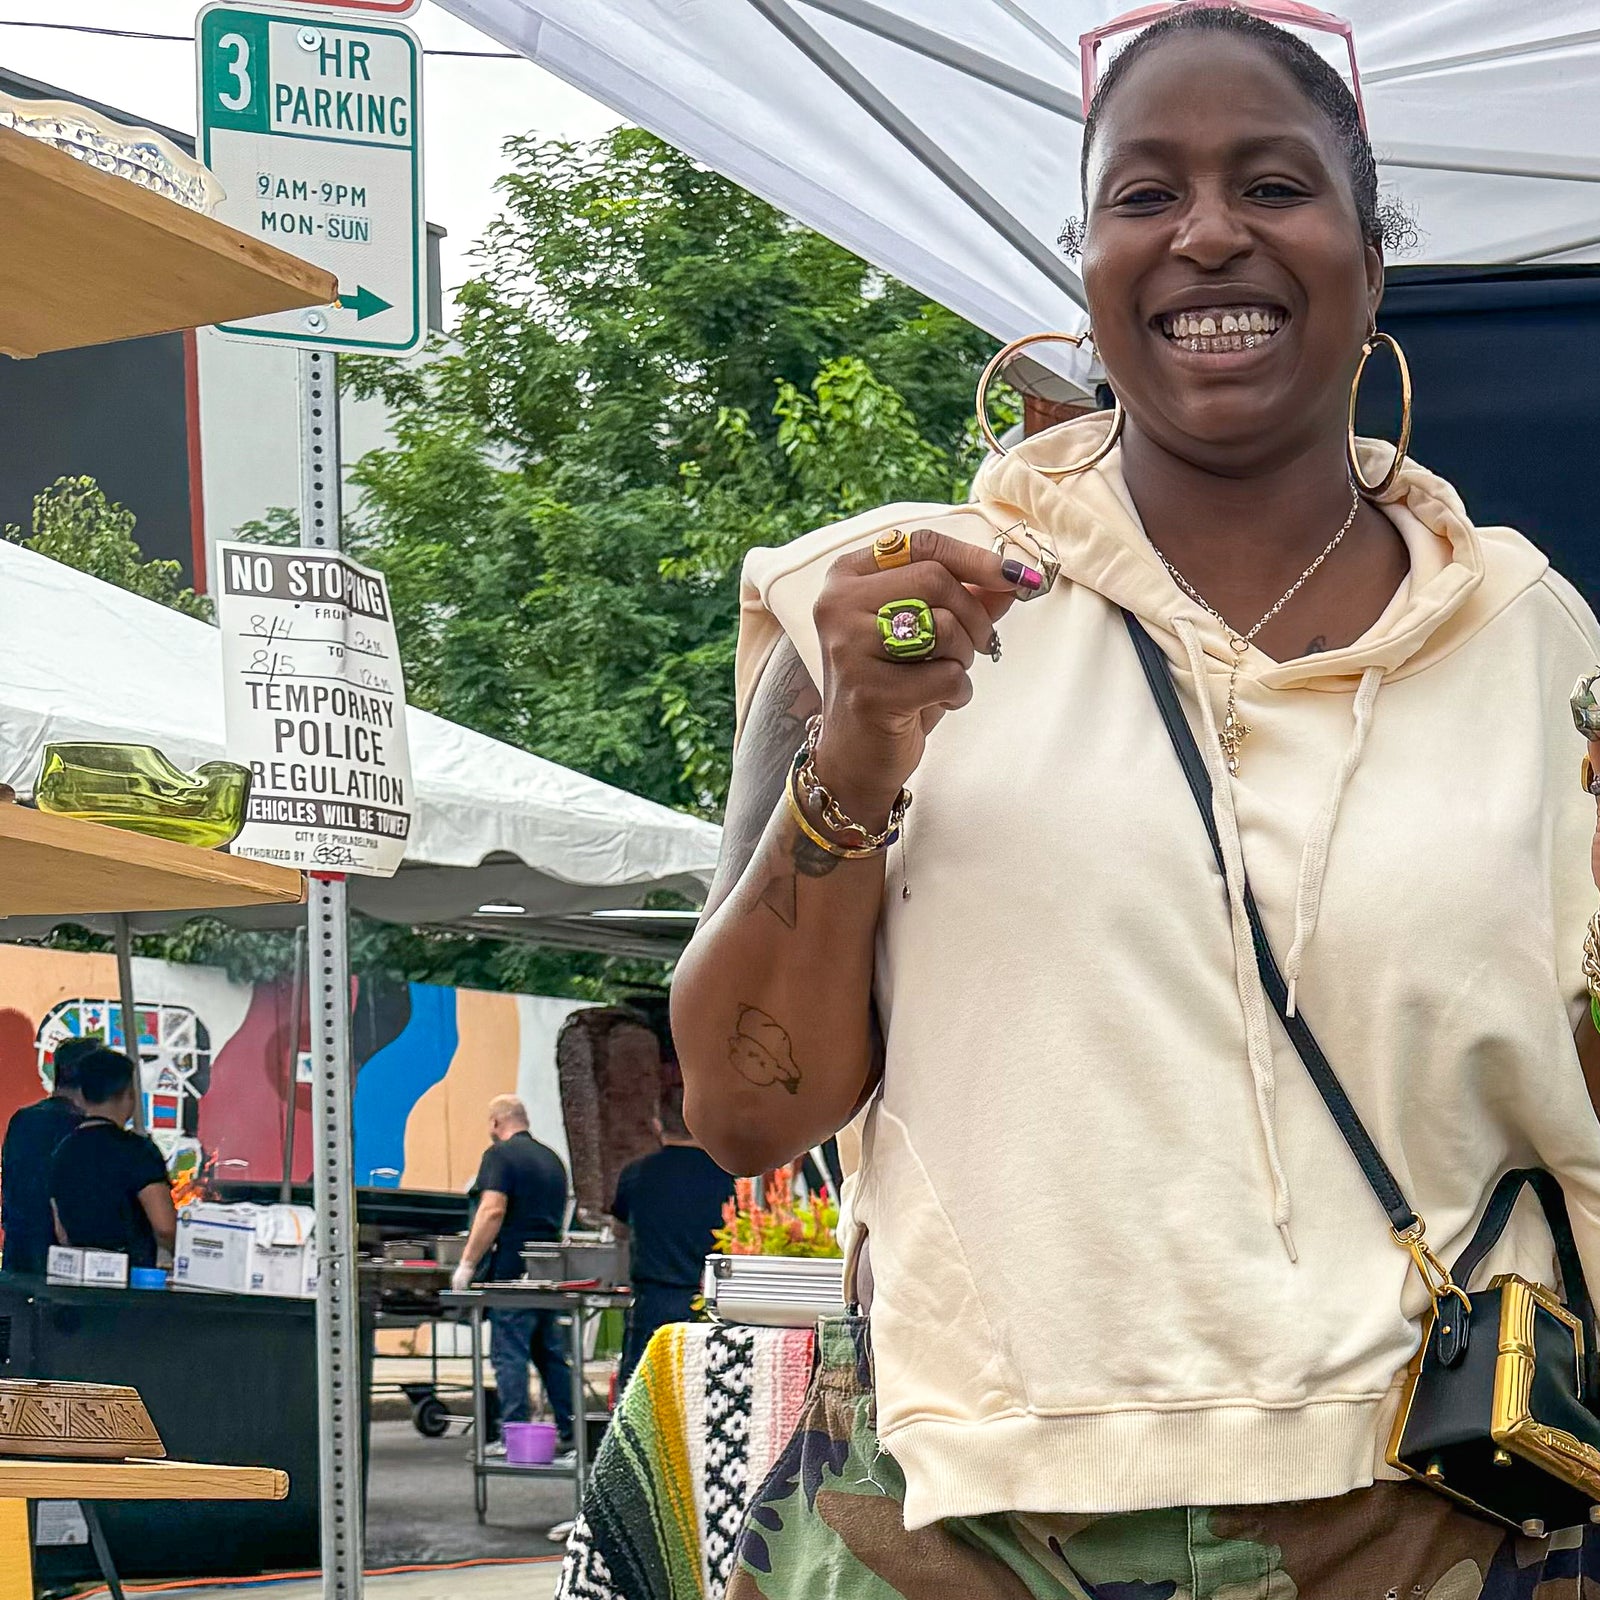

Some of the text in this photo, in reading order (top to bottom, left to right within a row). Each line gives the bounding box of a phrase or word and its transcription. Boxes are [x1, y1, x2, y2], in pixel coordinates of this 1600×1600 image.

[218, 33, 371, 111] 3 HR
[275, 83, 407, 137] PARKING
[258, 175, 366, 207] 9AM-9PM
[261, 210, 369, 241] MON-SUN
[231, 554, 274, 593] NO
[327, 646, 344, 658] TO
[245, 681, 394, 728] TEMPORARY
[274, 718, 386, 766] POLICE
[250, 760, 404, 806] REGULATION
[295, 831, 314, 842] CITY
[322, 804, 357, 828] WILL
[358, 808, 374, 831] BE
